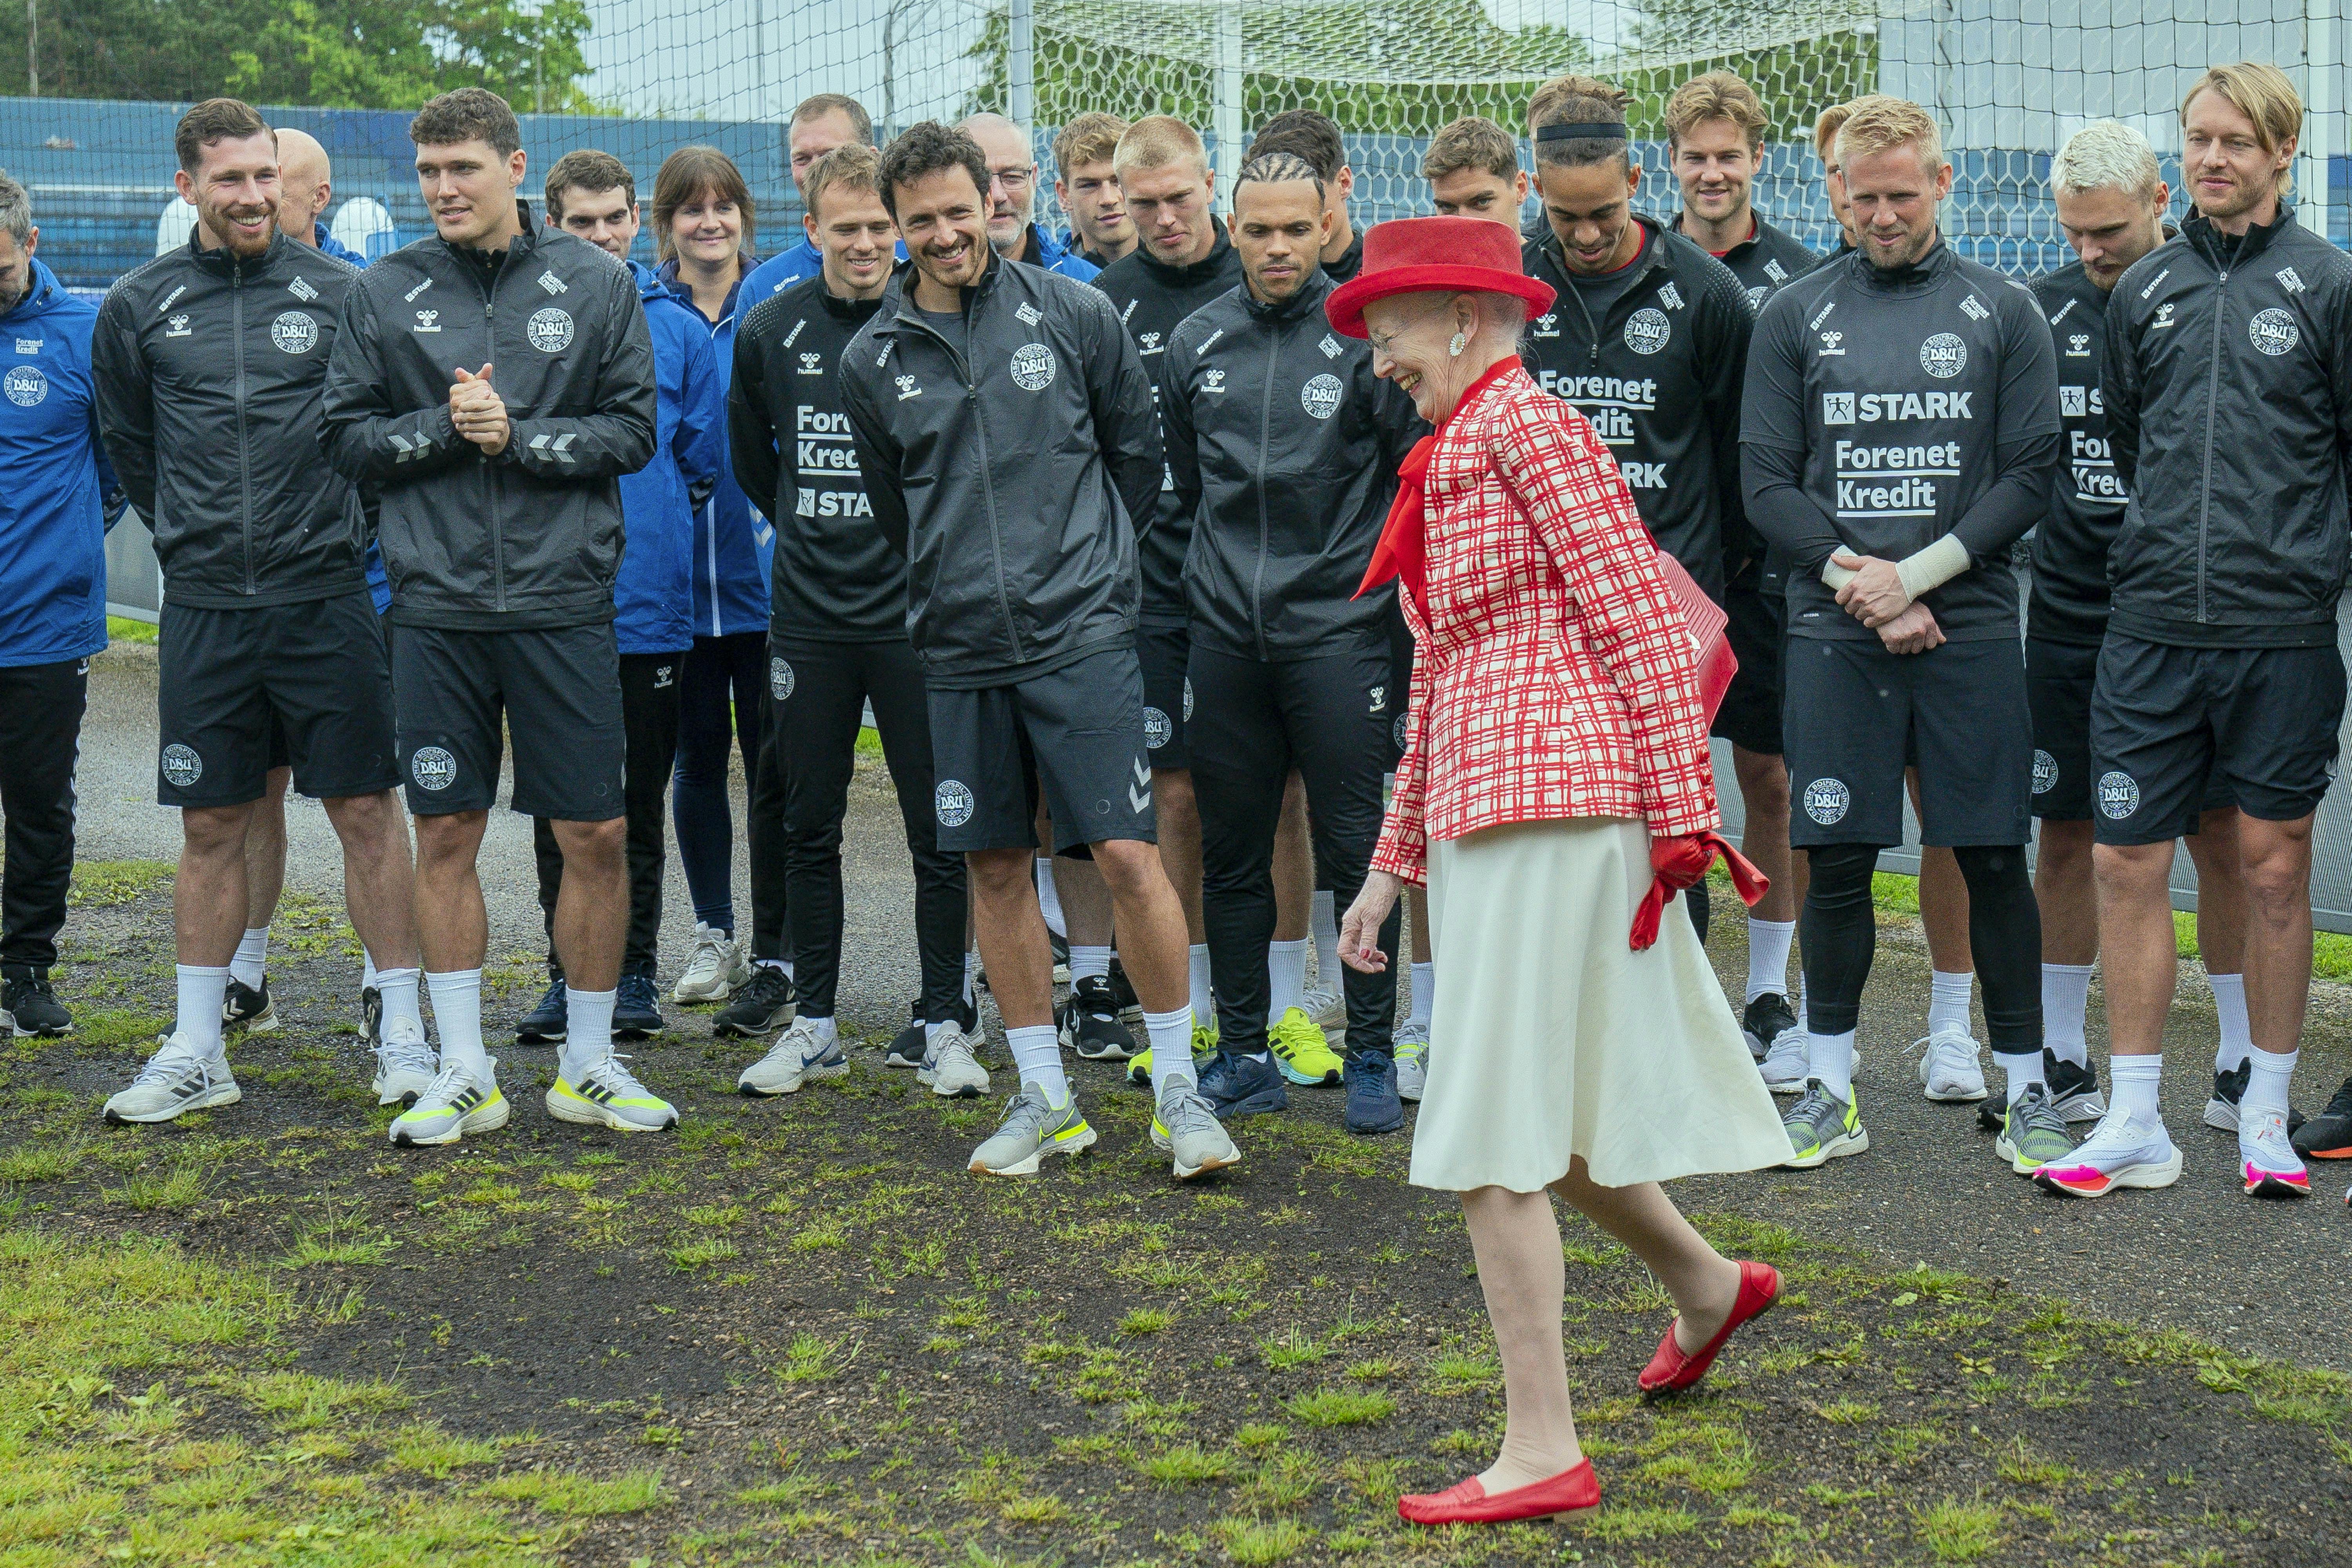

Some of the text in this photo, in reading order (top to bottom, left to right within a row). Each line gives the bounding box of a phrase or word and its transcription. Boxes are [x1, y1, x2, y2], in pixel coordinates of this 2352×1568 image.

[294, 276, 318, 298] Forenet
[412, 277, 433, 296] STARK
[538, 275, 558, 294] Kredit
[545, 270, 568, 292] Forenet
[2148, 269, 2170, 292] STARK
[2277, 270, 2296, 292] Kredit
[2285, 267, 2305, 291] Forenet
[165, 285, 187, 305] STARK
[289, 282, 309, 300] Kredit
[1659, 287, 1674, 309] Kredit
[1667, 281, 1684, 309] Forenet
[1816, 302, 1835, 324] STARK
[1960, 300, 1980, 320] Kredit
[1967, 294, 1989, 318] Forenet
[2058, 298, 2077, 319] STARK
[282, 325, 308, 338] DBU
[537, 322, 564, 336] DBU
[788, 319, 807, 341] STARK
[1204, 328, 1224, 349] STARK
[1633, 323, 1661, 338] DBU
[2259, 324, 2288, 339] DBU
[1819, 348, 1845, 357] hummel
[1930, 348, 1957, 361] DBU
[1020, 358, 1047, 374] DBU
[13, 379, 38, 392] DBU
[1310, 388, 1336, 402] DBU
[1540, 370, 1657, 403] Forenet
[1859, 392, 1973, 421] STARK
[1837, 441, 1960, 468] Forenet
[1837, 477, 1936, 508] Kredit
[818, 492, 874, 517] STA
[169, 758, 192, 770] DBU
[420, 761, 447, 774] DBU
[941, 795, 964, 809] DBU
[1806, 790, 1818, 818] DANSK
[1838, 792, 1847, 816] UNION
[1815, 794, 1840, 808] DBU
[2105, 788, 2129, 801] DBU
[2128, 786, 2137, 810] UNION
